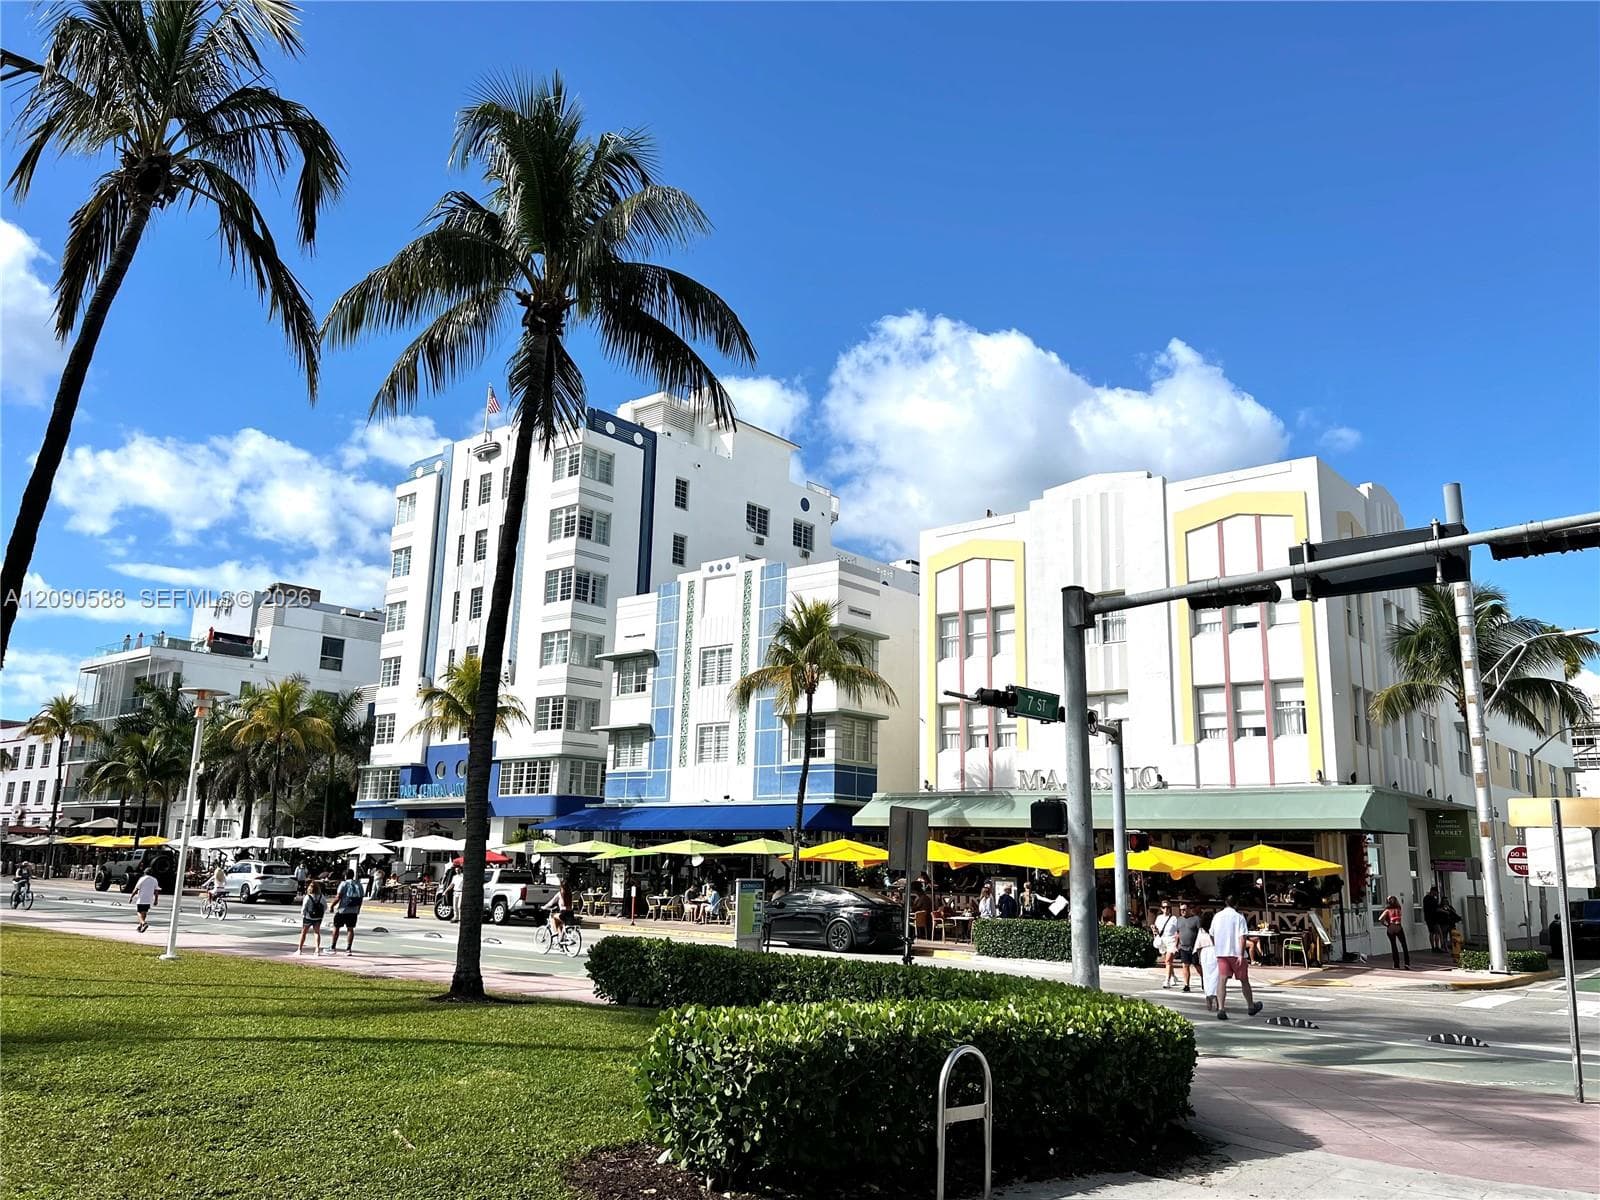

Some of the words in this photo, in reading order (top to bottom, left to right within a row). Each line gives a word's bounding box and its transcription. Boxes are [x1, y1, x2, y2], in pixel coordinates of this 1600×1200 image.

[1027, 695, 1034, 711] 7
[1037, 698, 1047, 712] ST
[1017, 766, 1159, 791] MASIC
[400, 785, 417, 798] PARK
[419, 784, 447, 798] CENTRAL
[450, 783, 465, 797] HOT
